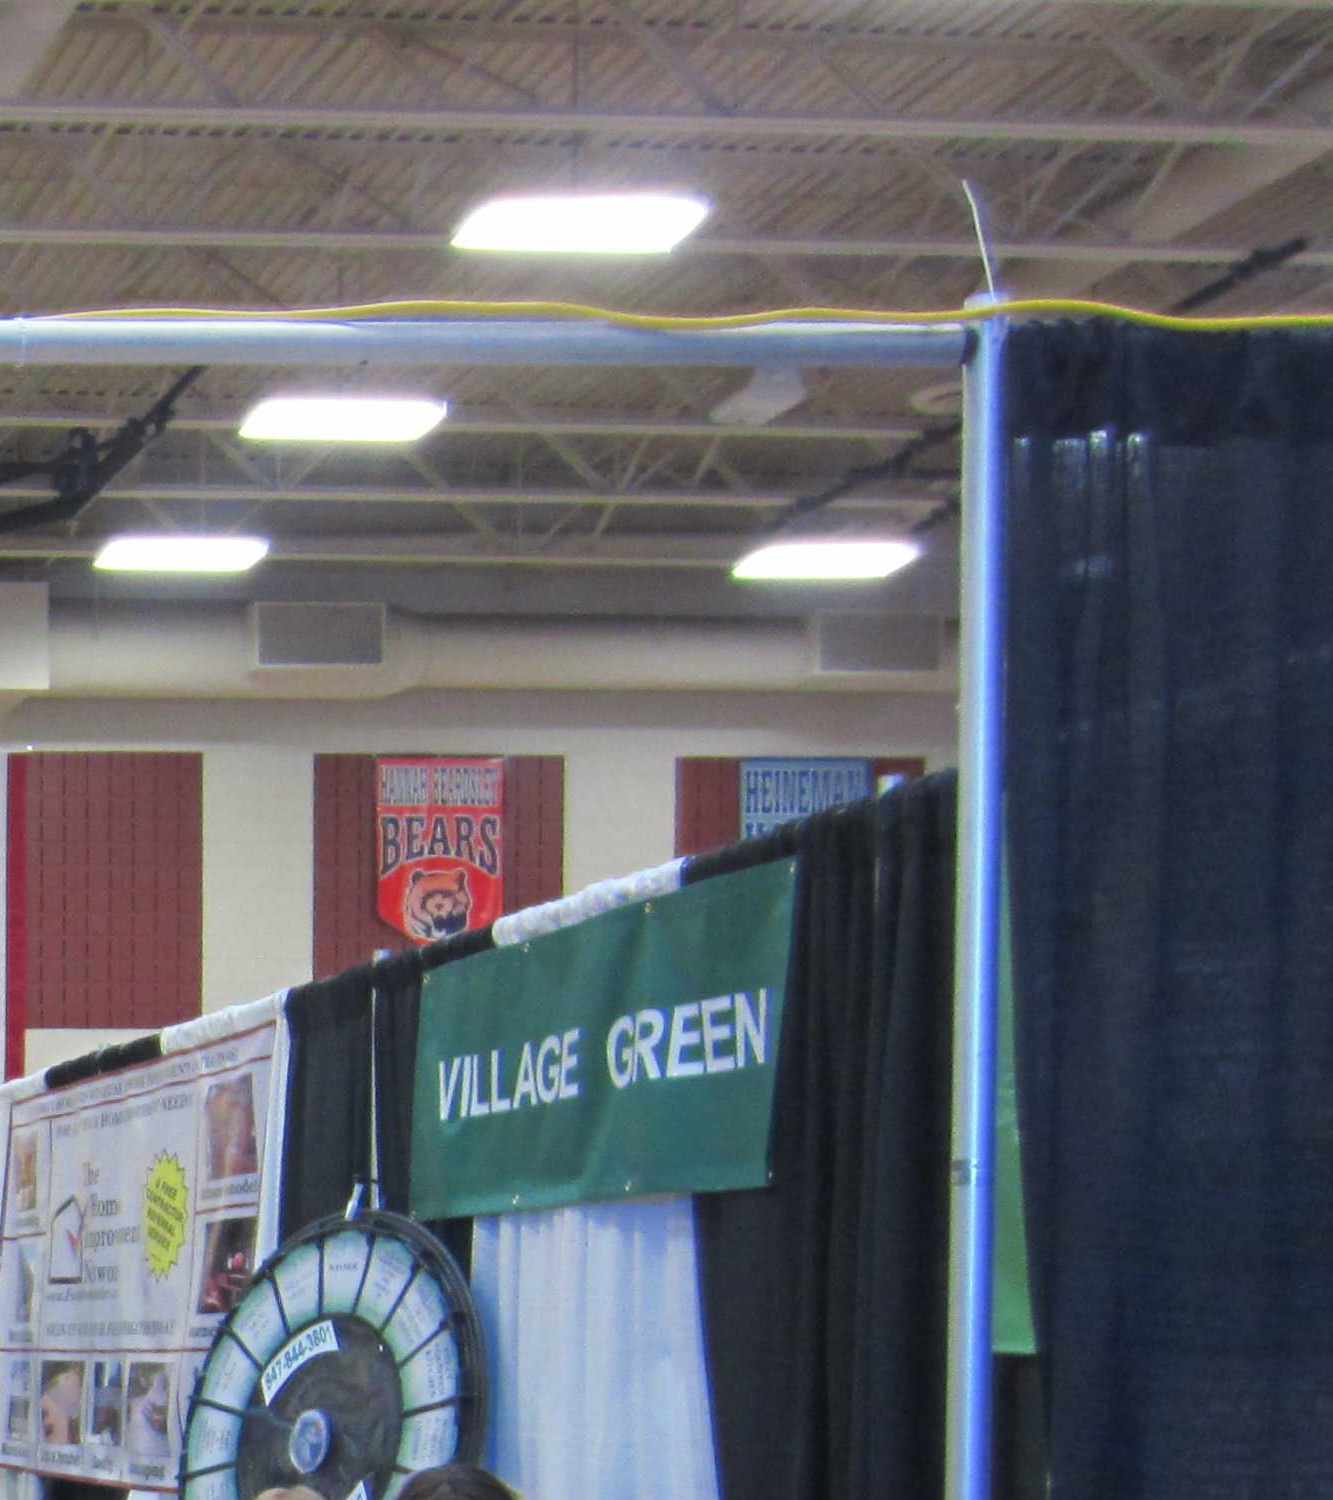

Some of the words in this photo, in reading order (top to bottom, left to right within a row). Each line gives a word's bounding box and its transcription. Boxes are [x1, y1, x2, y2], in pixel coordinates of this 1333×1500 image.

[380, 814, 500, 880] BEARS
[439, 1027, 582, 1121] VILLAGE
[605, 986, 768, 1089] GREEN
